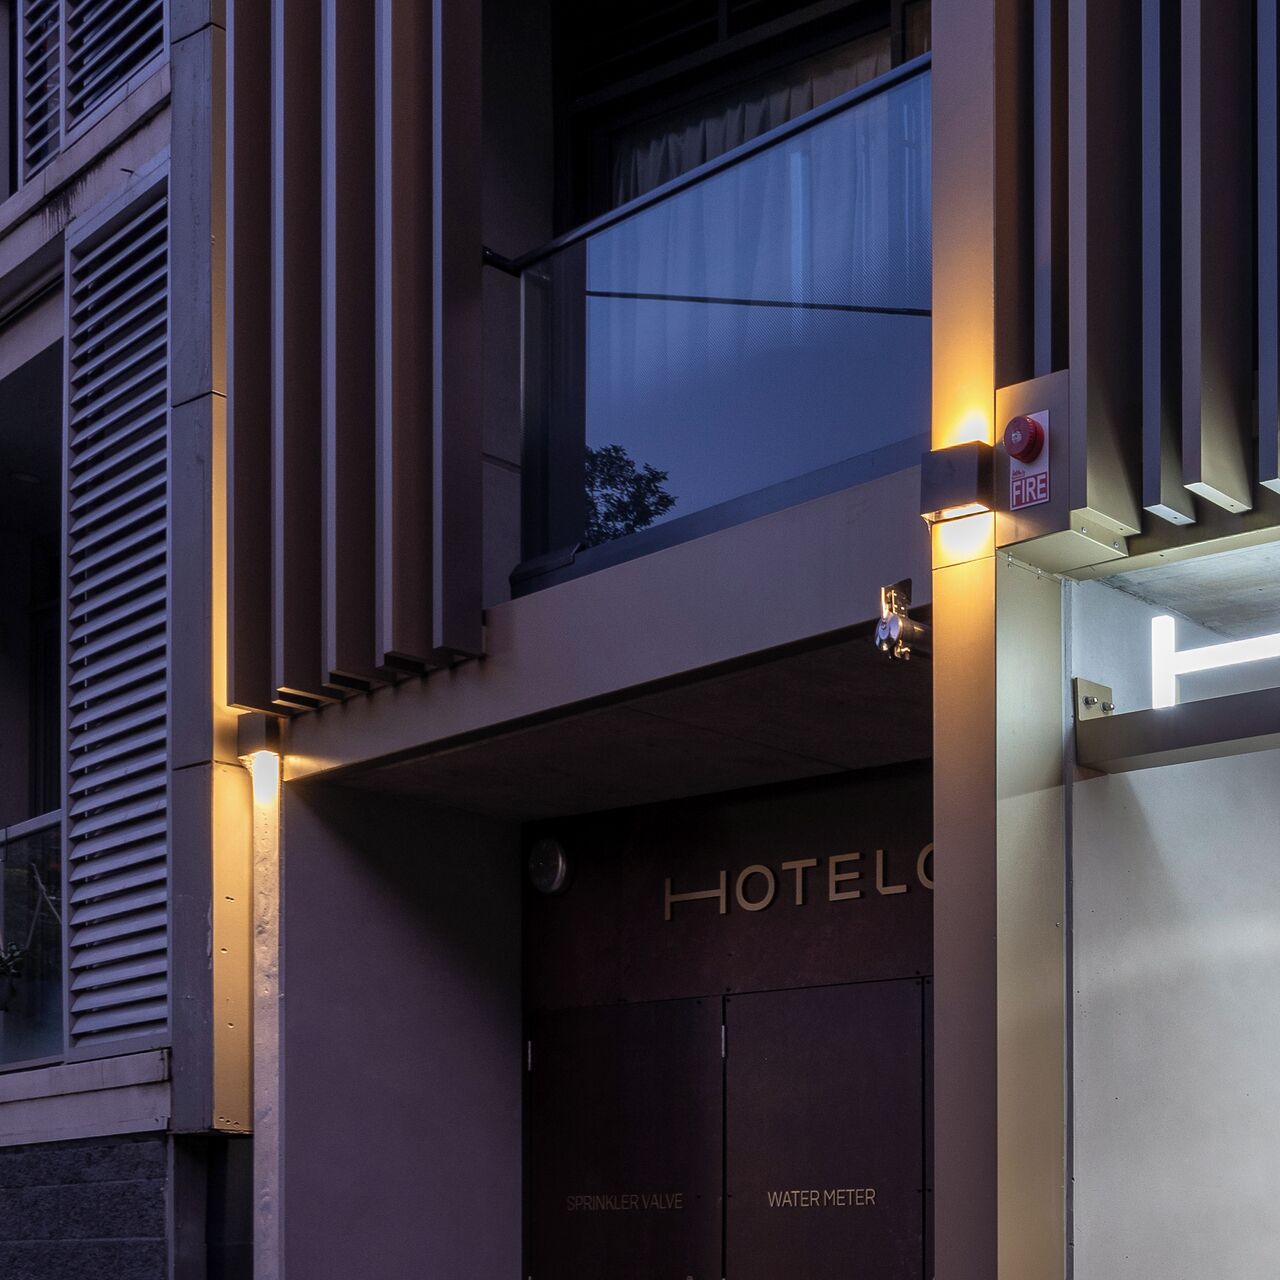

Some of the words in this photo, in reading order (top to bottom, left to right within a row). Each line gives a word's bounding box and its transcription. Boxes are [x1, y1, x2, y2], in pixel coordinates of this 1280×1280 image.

[1012, 473, 1047, 506] FIRE
[567, 1194, 639, 1211] SPRINKLER
[641, 1193, 684, 1209] VALVE
[767, 1190, 821, 1207] WATER
[823, 1188, 876, 1206] METER
